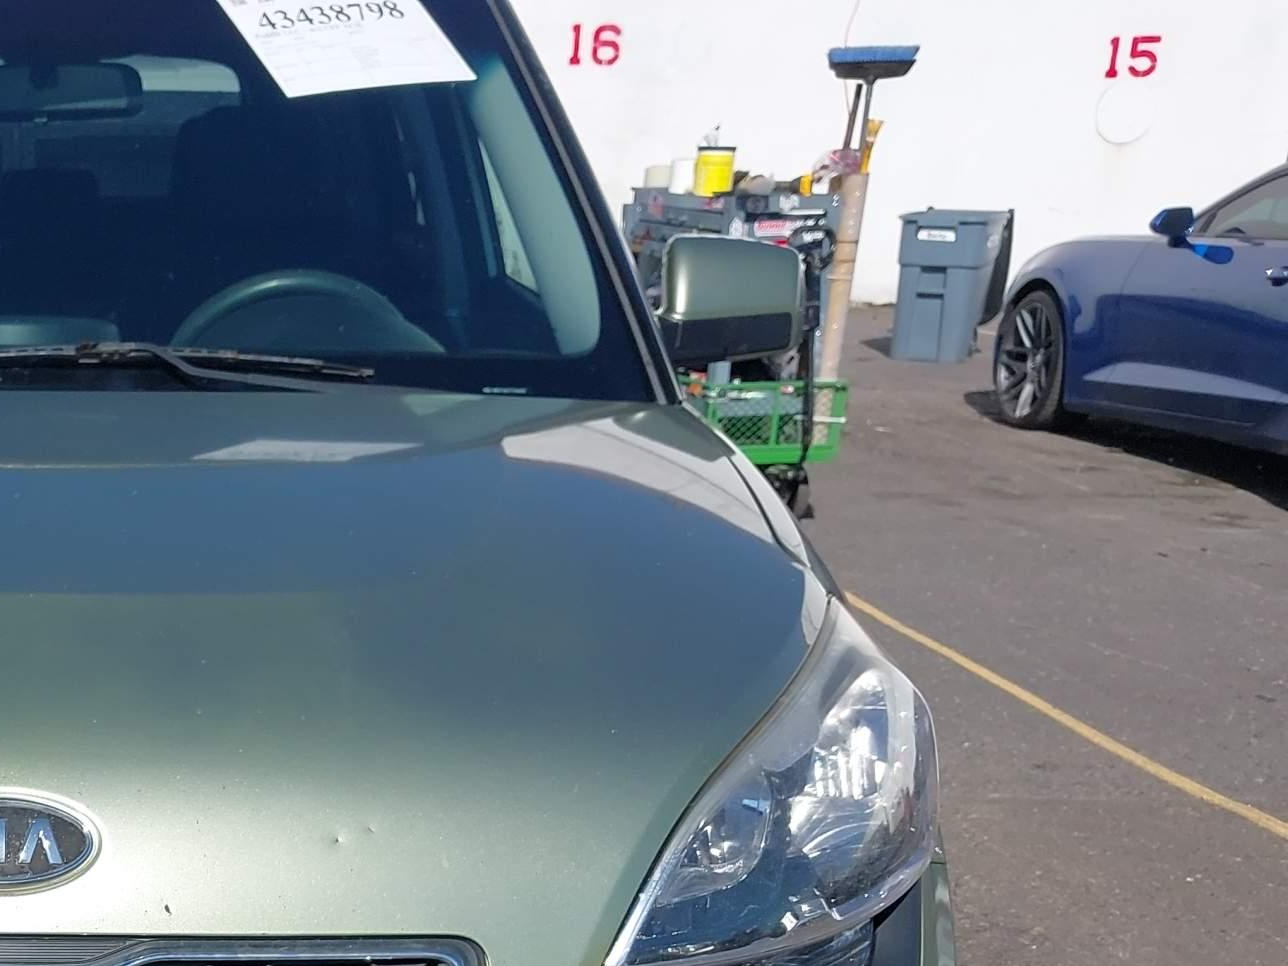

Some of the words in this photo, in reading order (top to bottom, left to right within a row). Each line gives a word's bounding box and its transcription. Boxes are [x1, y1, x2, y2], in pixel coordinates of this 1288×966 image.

[258, 0, 405, 30] 43438798
[569, 24, 622, 65] 16
[1105, 35, 1162, 78] 15
